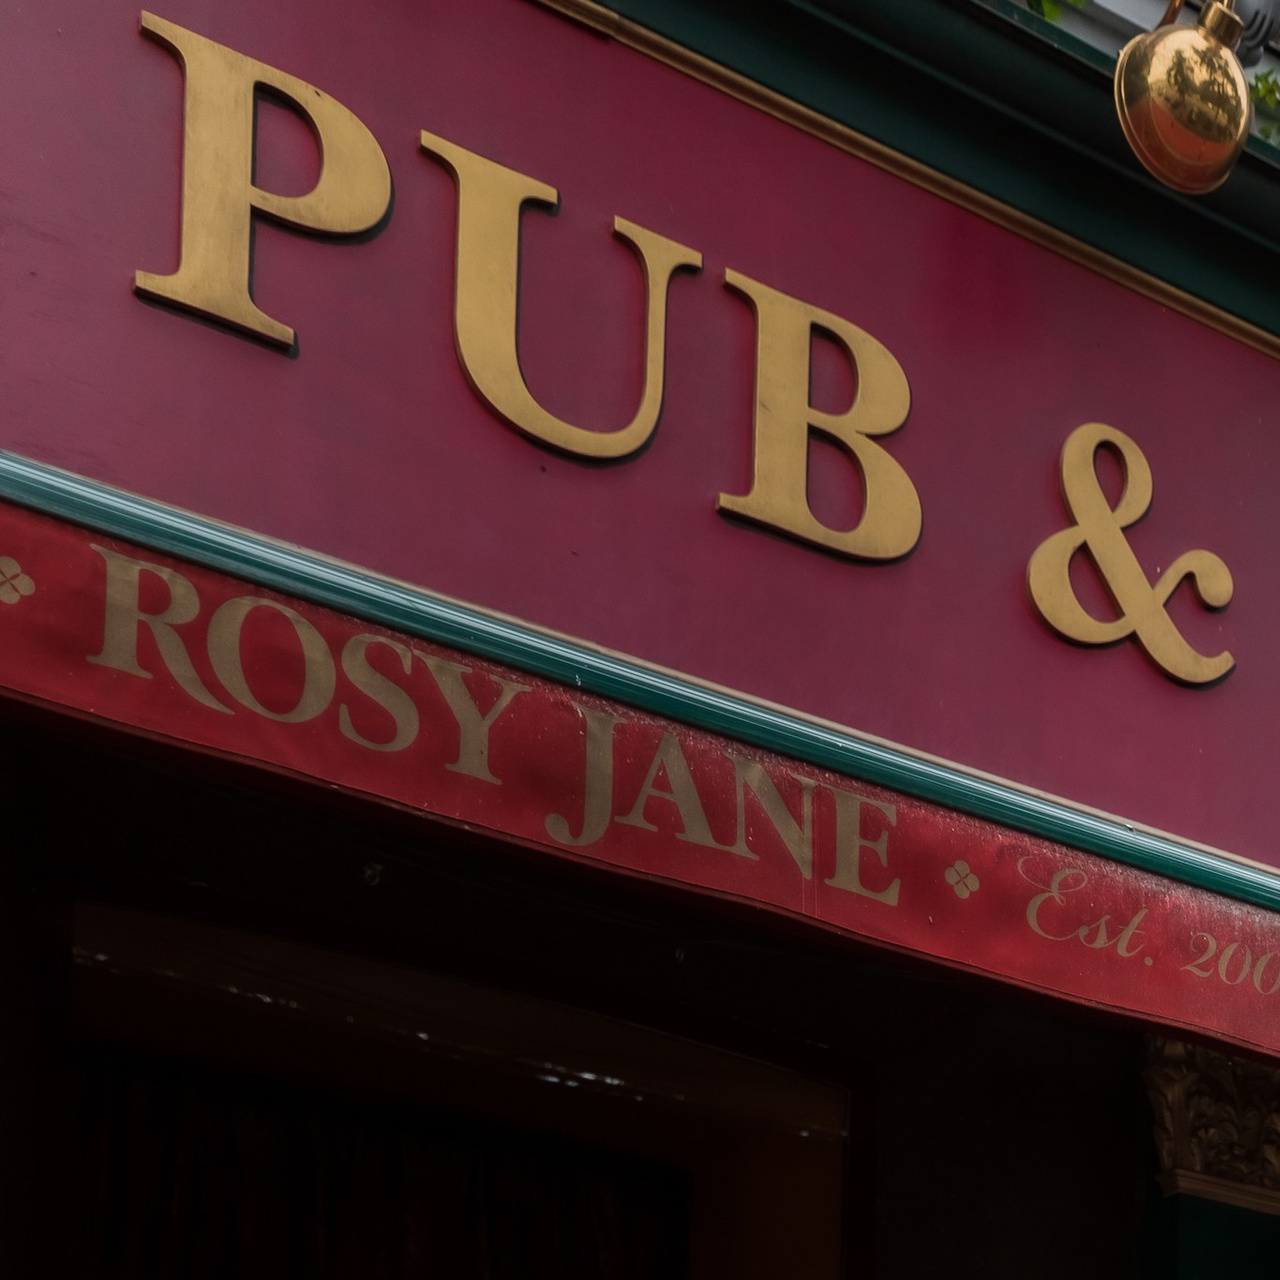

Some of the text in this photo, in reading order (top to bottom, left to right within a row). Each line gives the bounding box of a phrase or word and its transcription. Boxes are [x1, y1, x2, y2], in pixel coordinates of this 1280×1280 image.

[134, 10, 925, 563] PUB
[1027, 422, 1236, 686] &
[86, 543, 533, 786] ROSY
[544, 706, 901, 907] JANE
[1016, 855, 1154, 967] Est.
